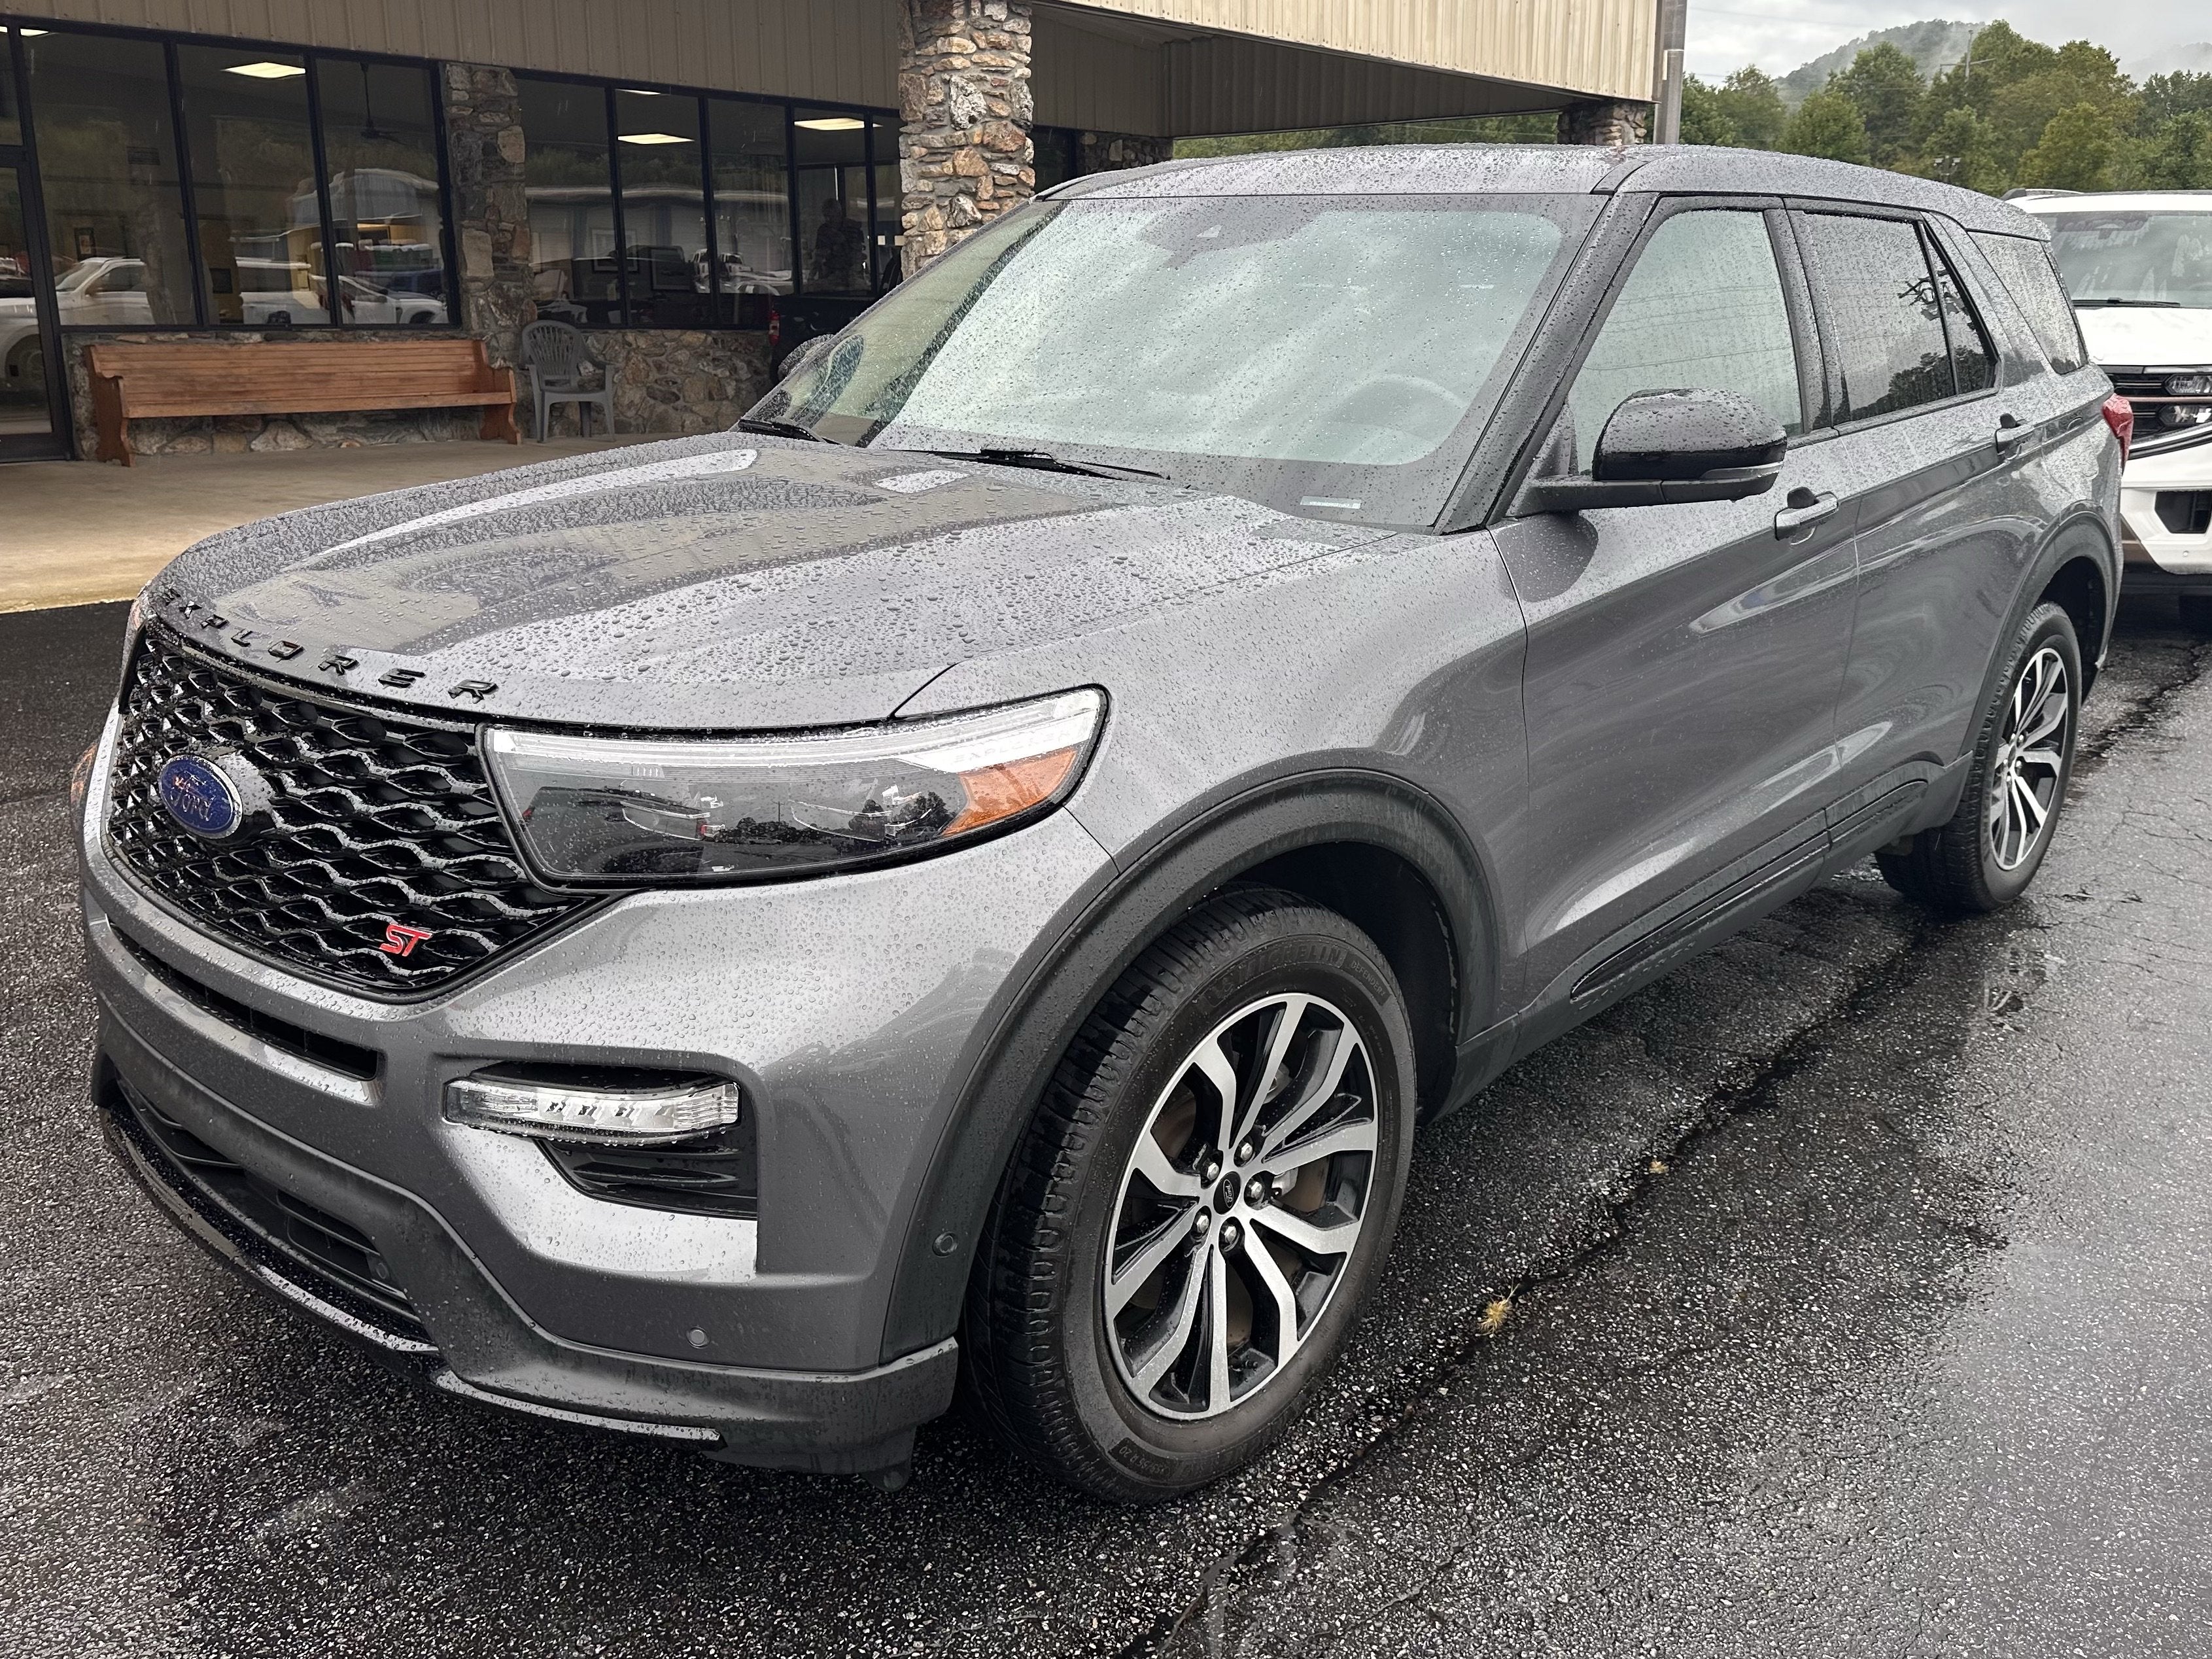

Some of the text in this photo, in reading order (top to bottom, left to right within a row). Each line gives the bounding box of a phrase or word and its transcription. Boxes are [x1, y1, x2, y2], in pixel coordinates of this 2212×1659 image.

[164, 587, 498, 704] EXPLORER
[379, 924, 432, 956] ST
[1119, 1446, 1132, 1458] 20
